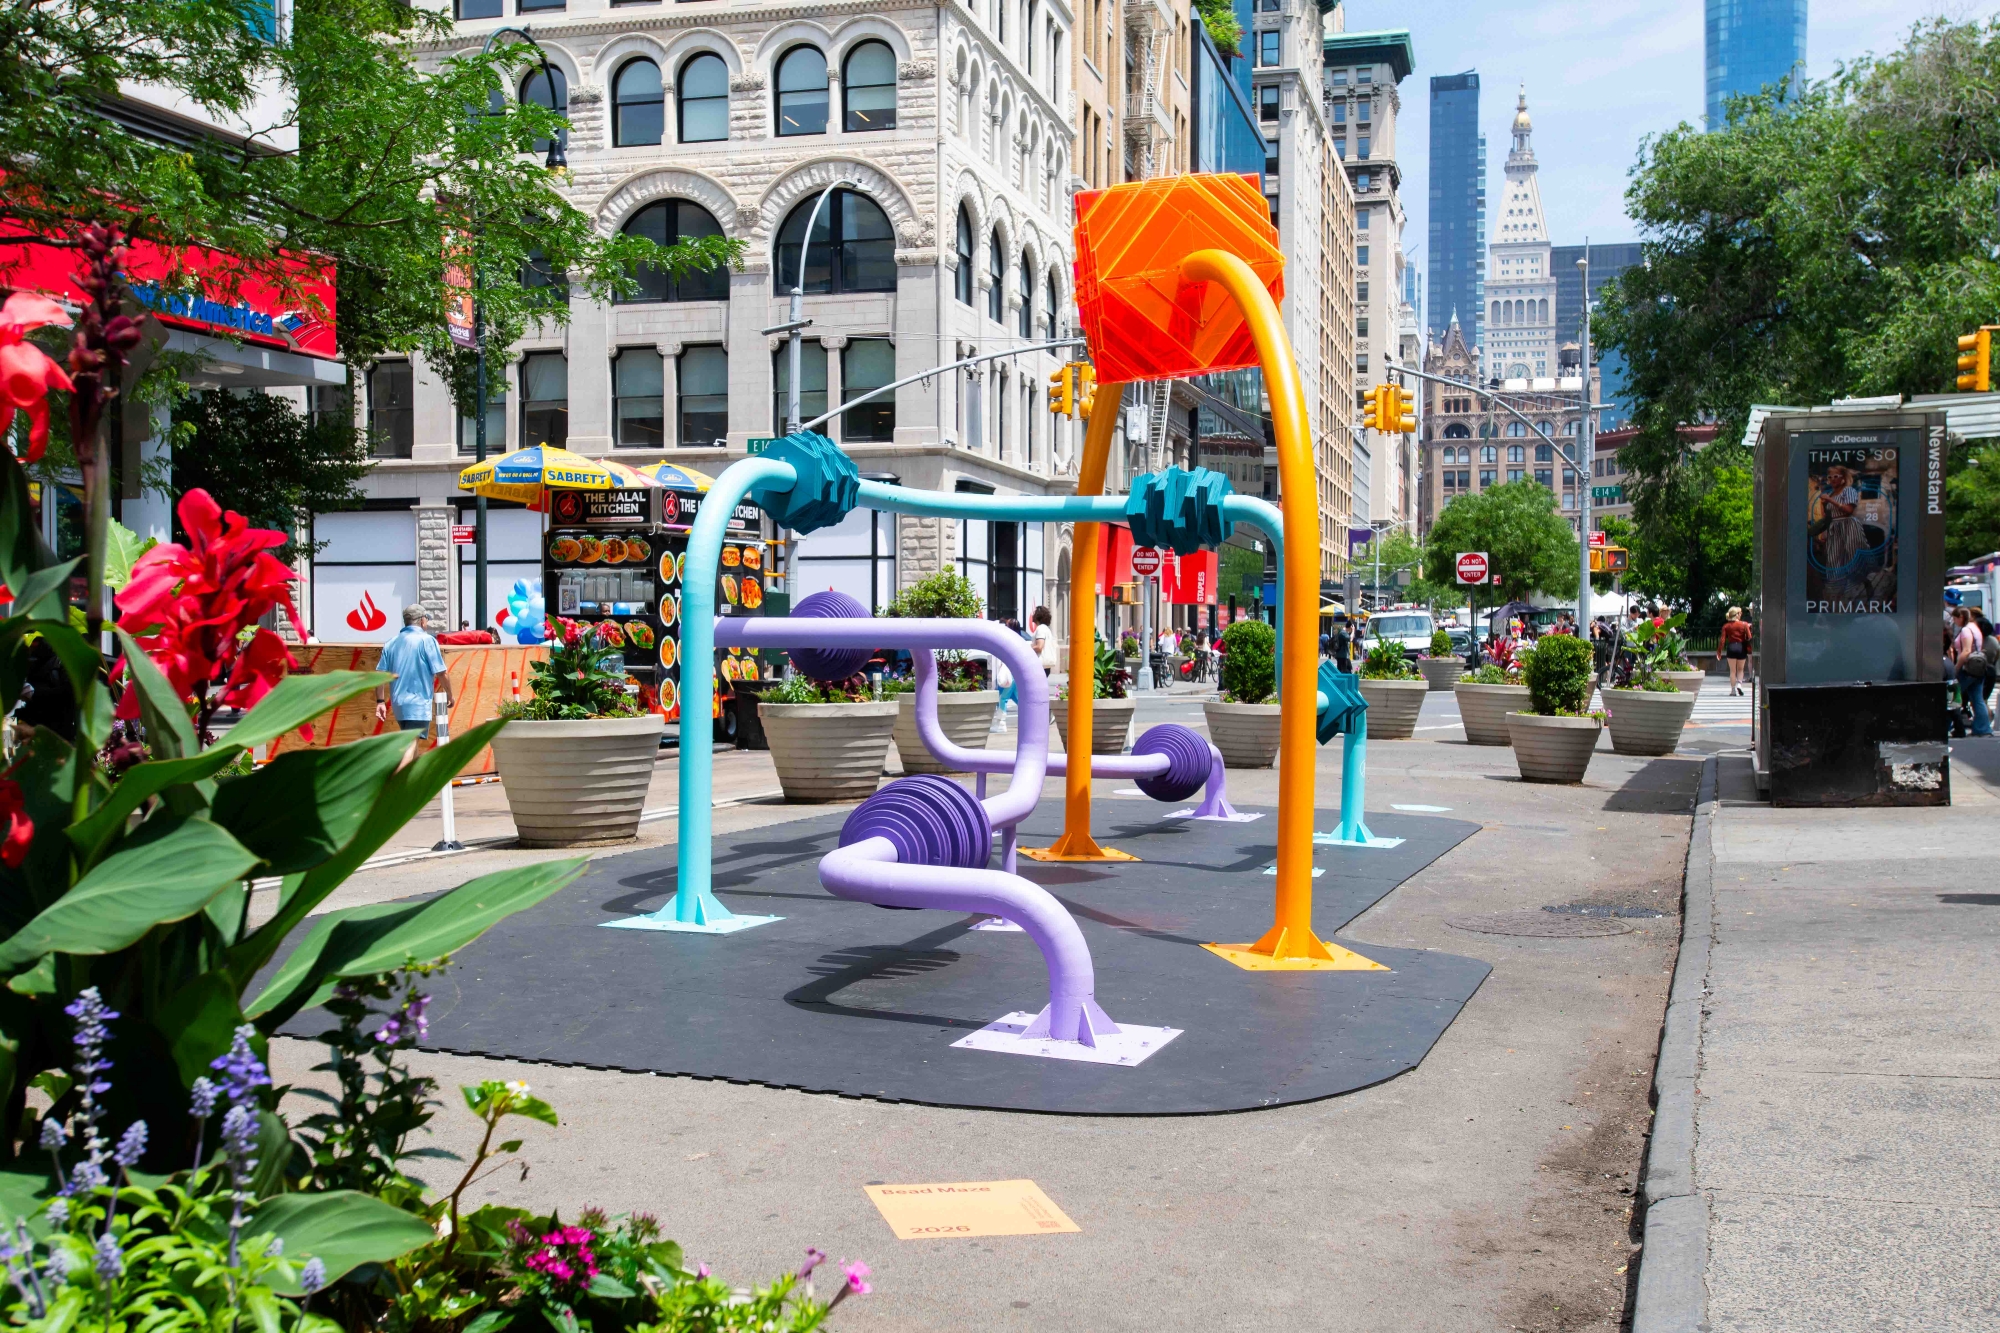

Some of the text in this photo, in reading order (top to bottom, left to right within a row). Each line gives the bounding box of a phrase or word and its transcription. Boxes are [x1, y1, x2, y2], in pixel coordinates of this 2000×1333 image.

[190, 293, 273, 335] America
[1831, 434, 1878, 444] JCDecaux
[753, 440, 759, 452] E
[1809, 449, 1897, 463] THAT'S SO
[1927, 425, 1945, 515] Newsstand
[460, 470, 492, 485] SABRETT
[547, 470, 607, 485] SABRETT
[584, 491, 646, 503] THE HALAL
[1595, 488, 1600, 497] E
[1602, 487, 1609, 496] 14
[590, 503, 639, 515] KITCHEN
[679, 498, 697, 514] THE
[732, 504, 759, 520] TCHEN
[1197, 571, 1205, 602] STAPLES
[1806, 600, 1893, 613] PRIMARK
[881, 1187, 933, 1195] Bead
[909, 1224, 971, 1234] 2026
